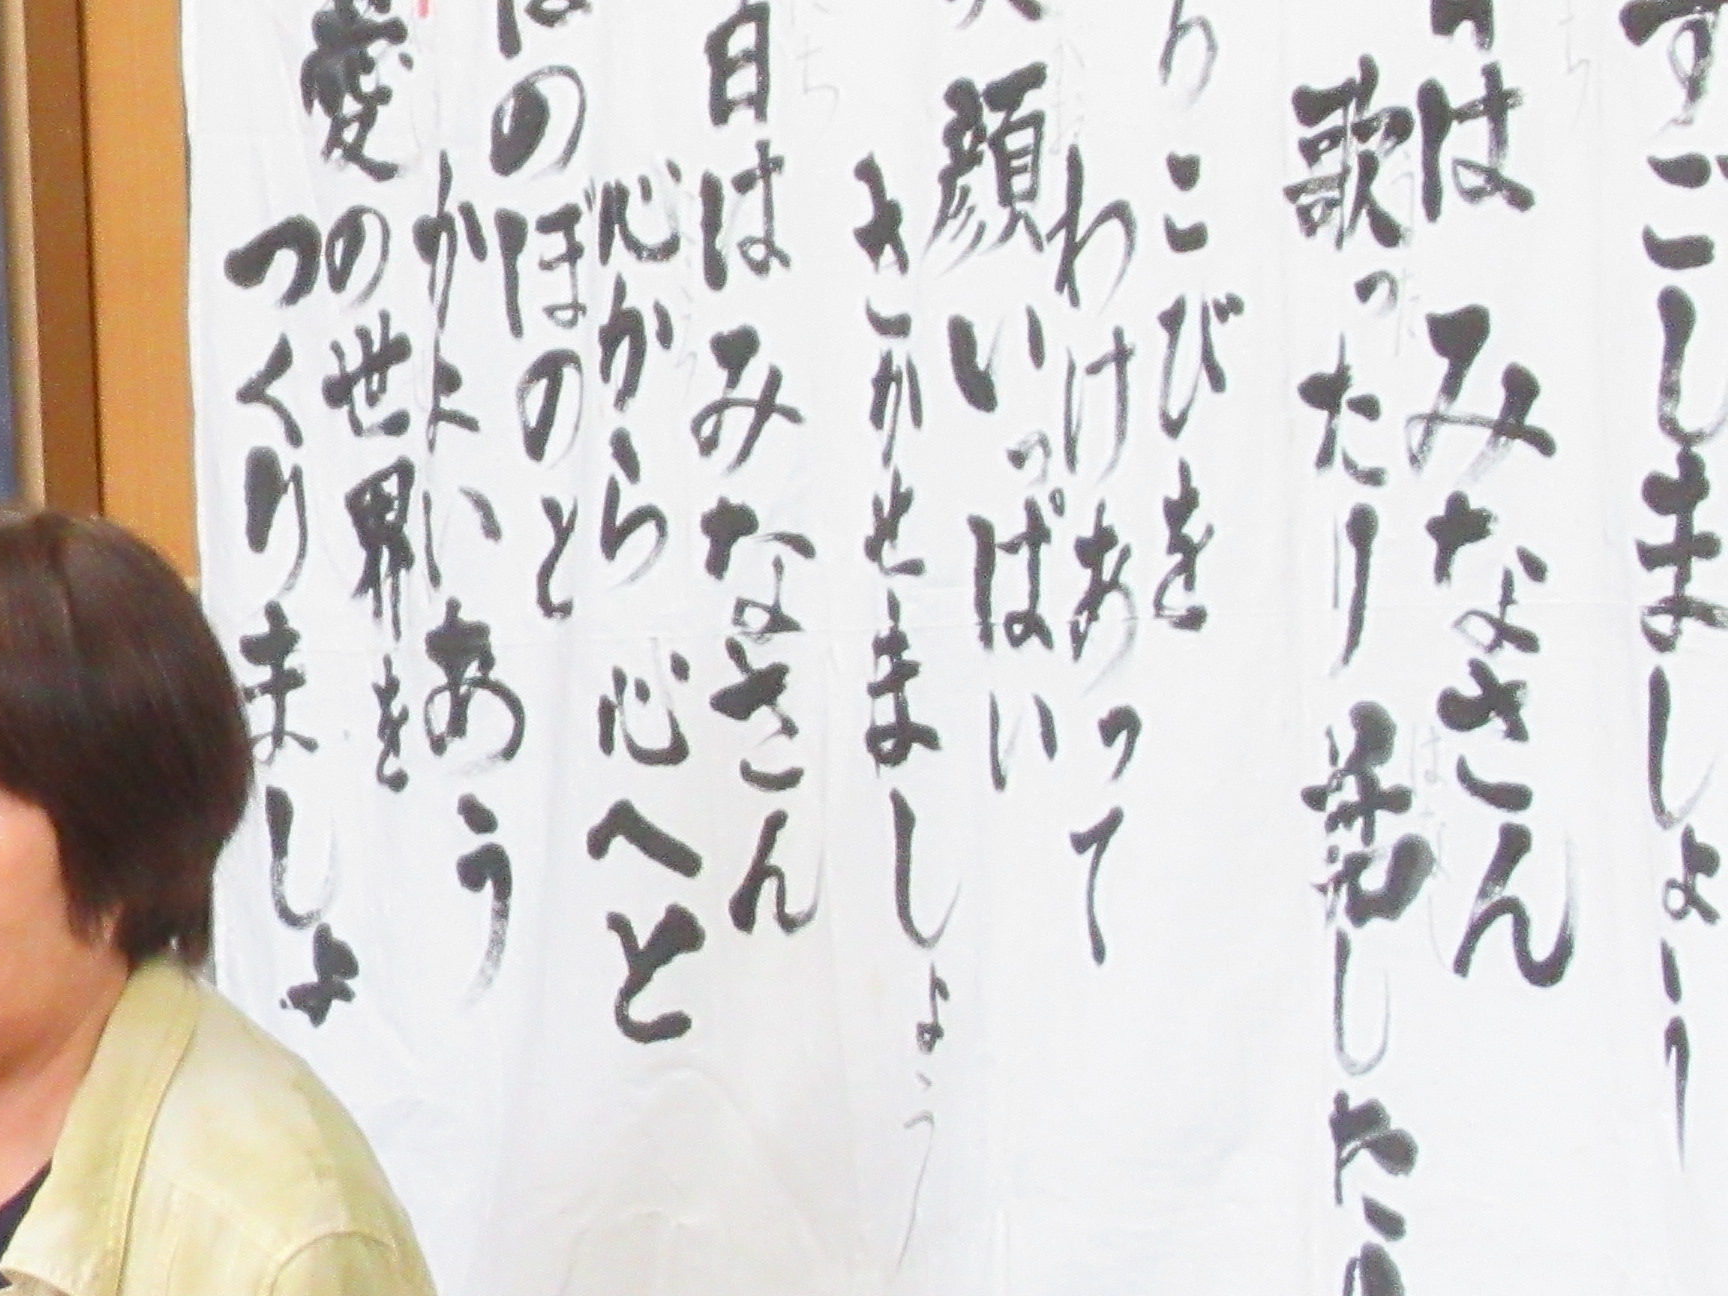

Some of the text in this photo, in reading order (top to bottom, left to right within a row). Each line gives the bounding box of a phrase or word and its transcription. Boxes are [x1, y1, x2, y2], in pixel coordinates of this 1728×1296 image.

[410, 149, 529, 1009] かよいあう
[1037, 143, 1144, 966] わけあって
